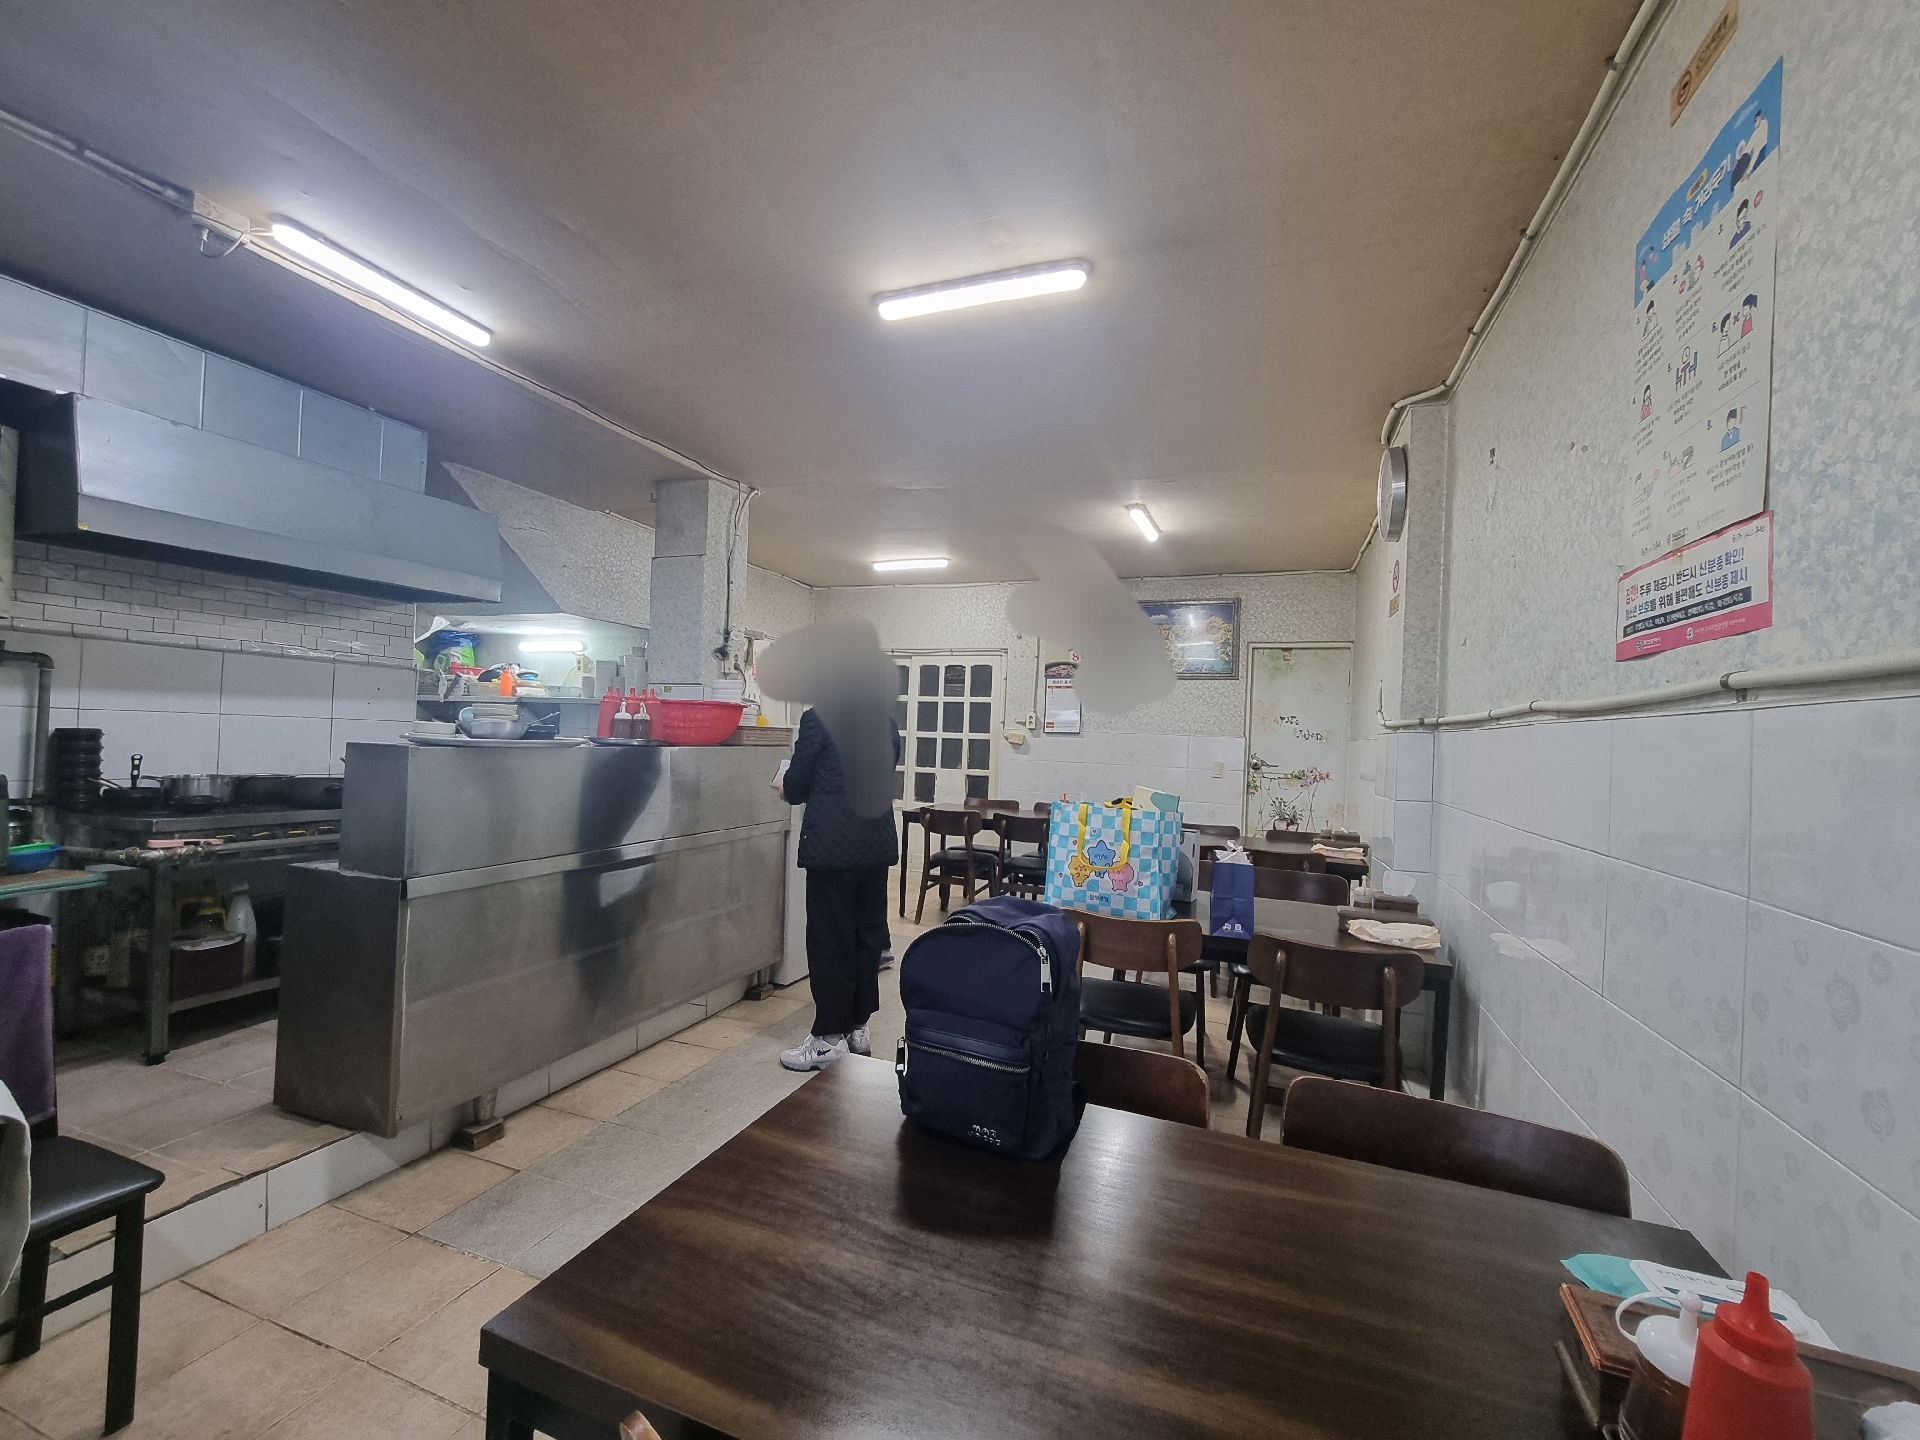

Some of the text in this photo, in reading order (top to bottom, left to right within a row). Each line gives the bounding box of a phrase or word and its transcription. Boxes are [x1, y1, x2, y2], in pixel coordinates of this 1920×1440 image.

[1682, 206, 1693, 226] 속
[1694, 153, 1731, 214] 거리두기
[1638, 597, 1657, 615] 보호를
[1658, 592, 1674, 610] 위해
[1675, 582, 1703, 606] 불편해도
[1639, 582, 1652, 597] 주류
[1676, 568, 1697, 586] 반드시
